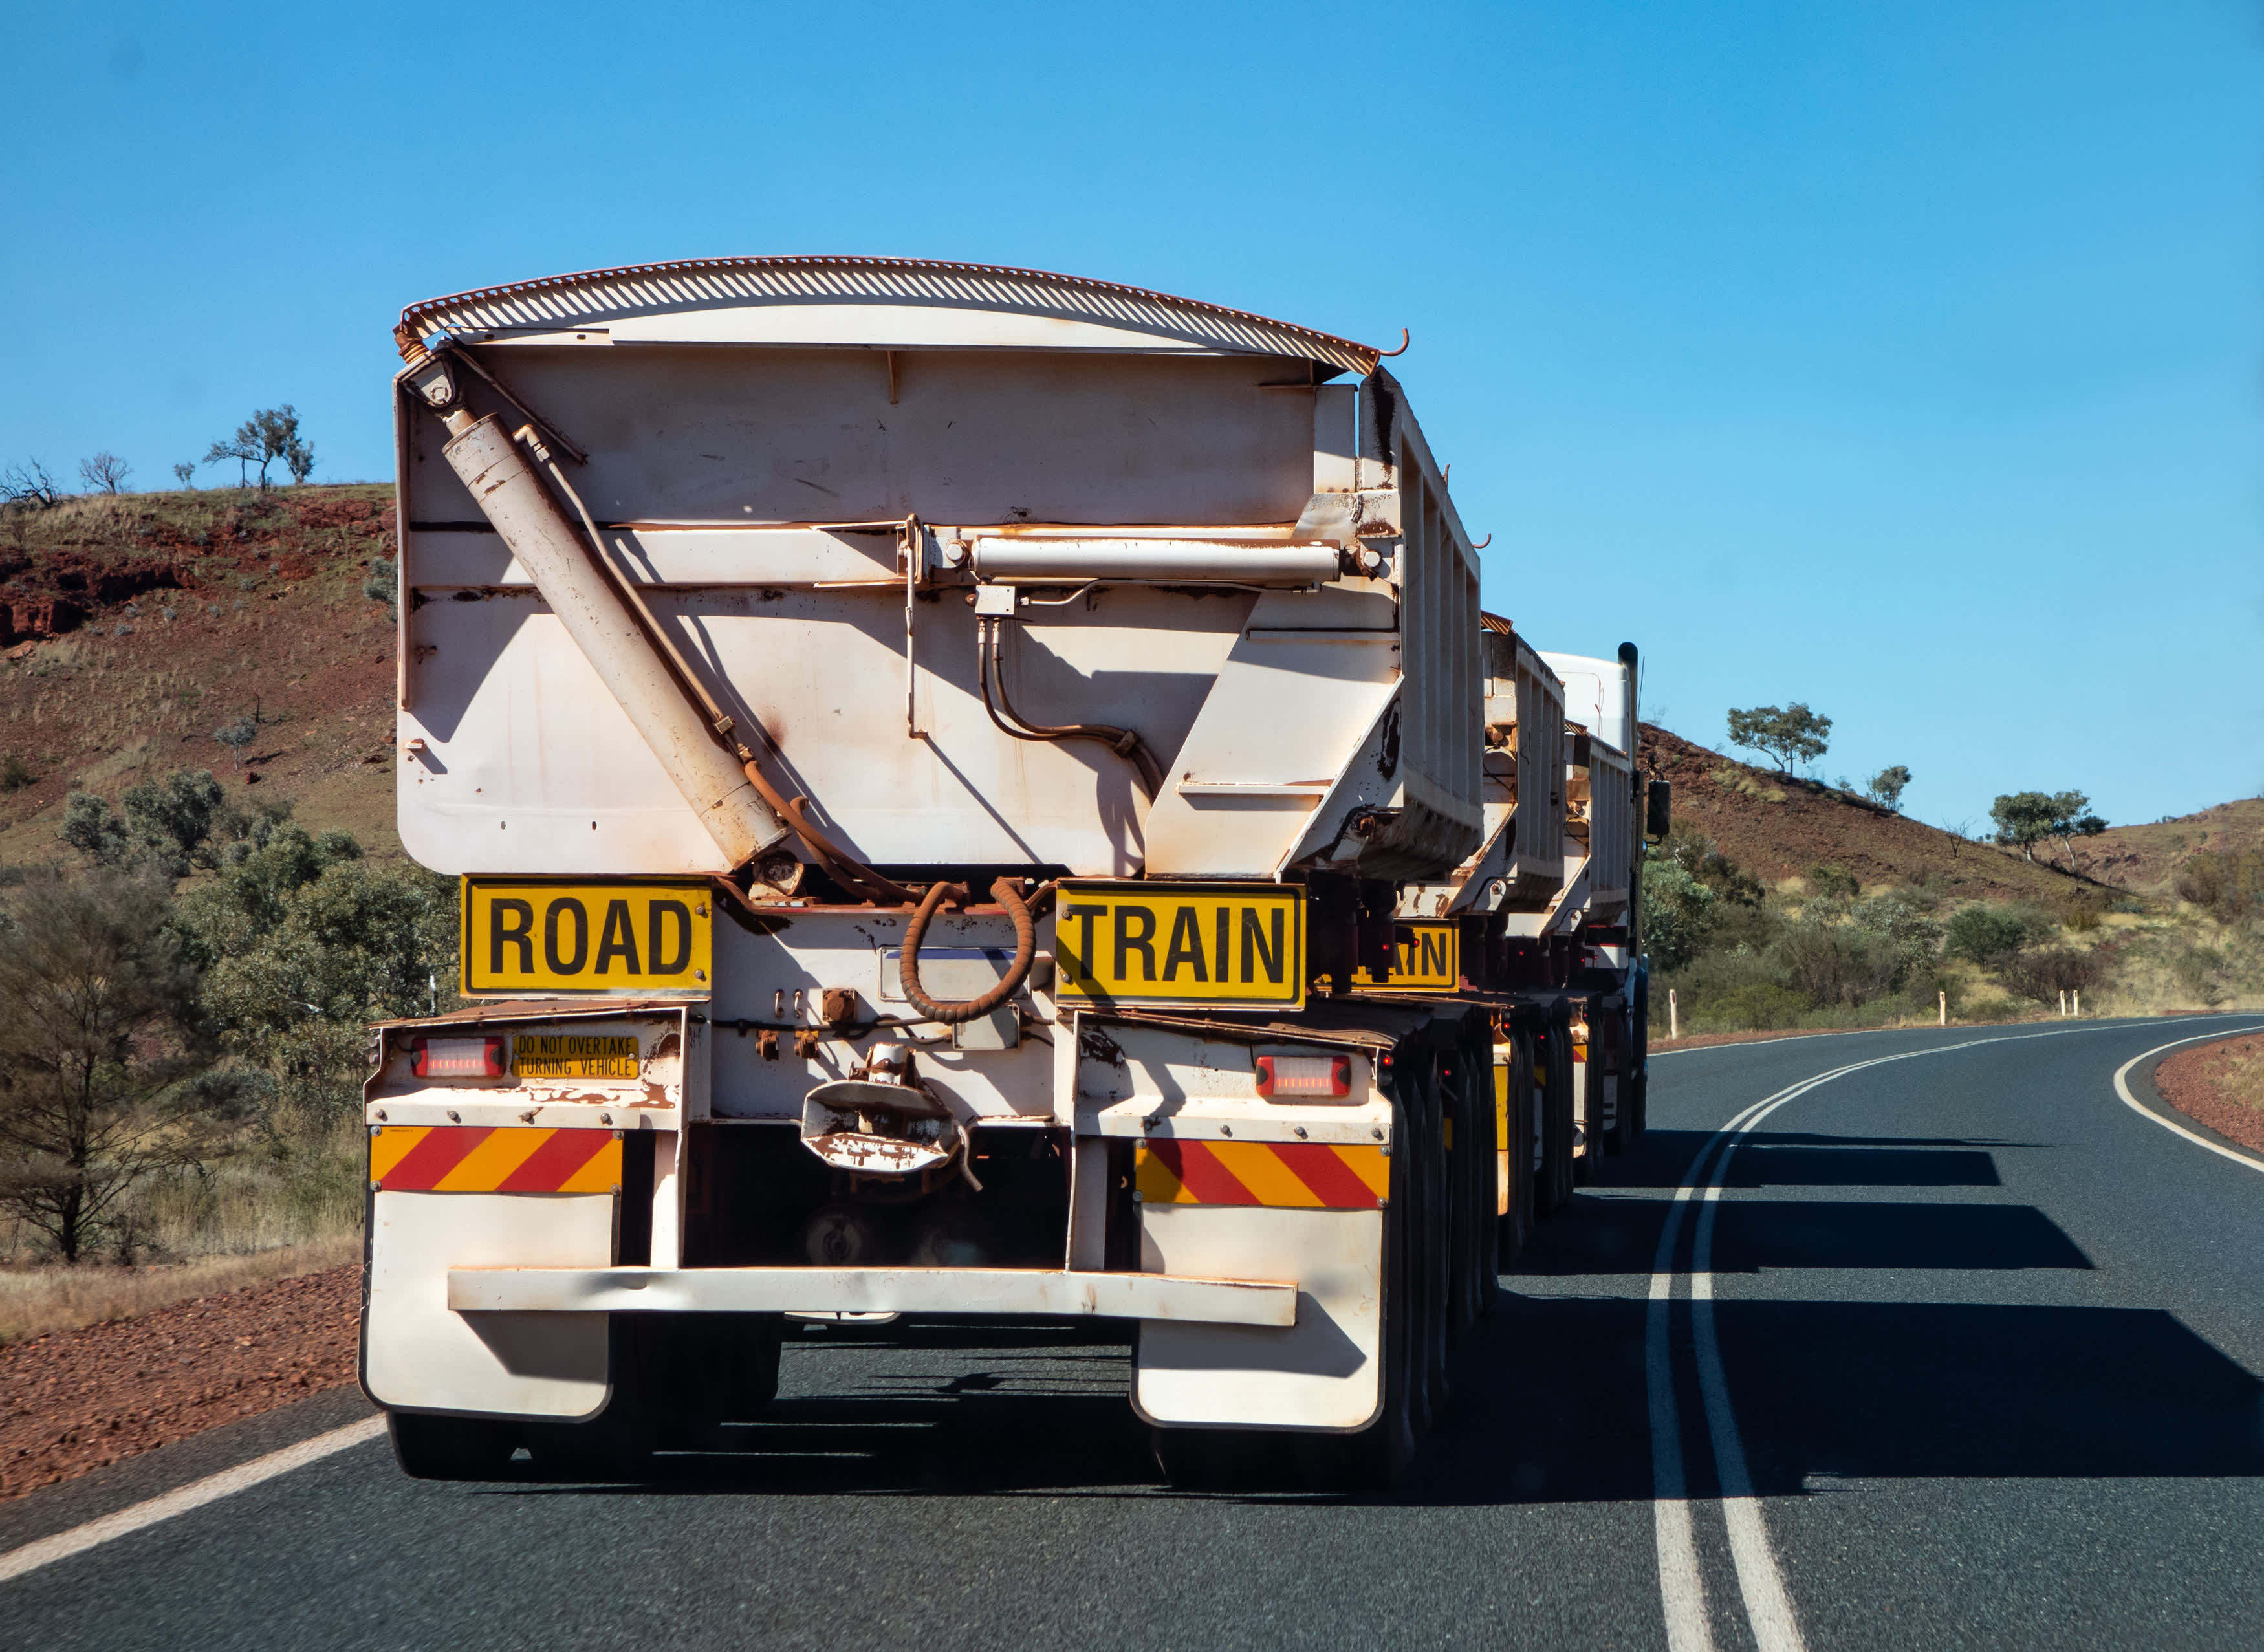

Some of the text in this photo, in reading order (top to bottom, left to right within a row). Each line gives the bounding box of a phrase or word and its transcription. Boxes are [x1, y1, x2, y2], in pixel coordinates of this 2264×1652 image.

[490, 897, 692, 975] ROAD
[1067, 904, 1284, 983] TRAIN
[519, 1036, 632, 1055] DO NOT OVERTAKE
[520, 1057, 631, 1076] TURNING VEHICLE
